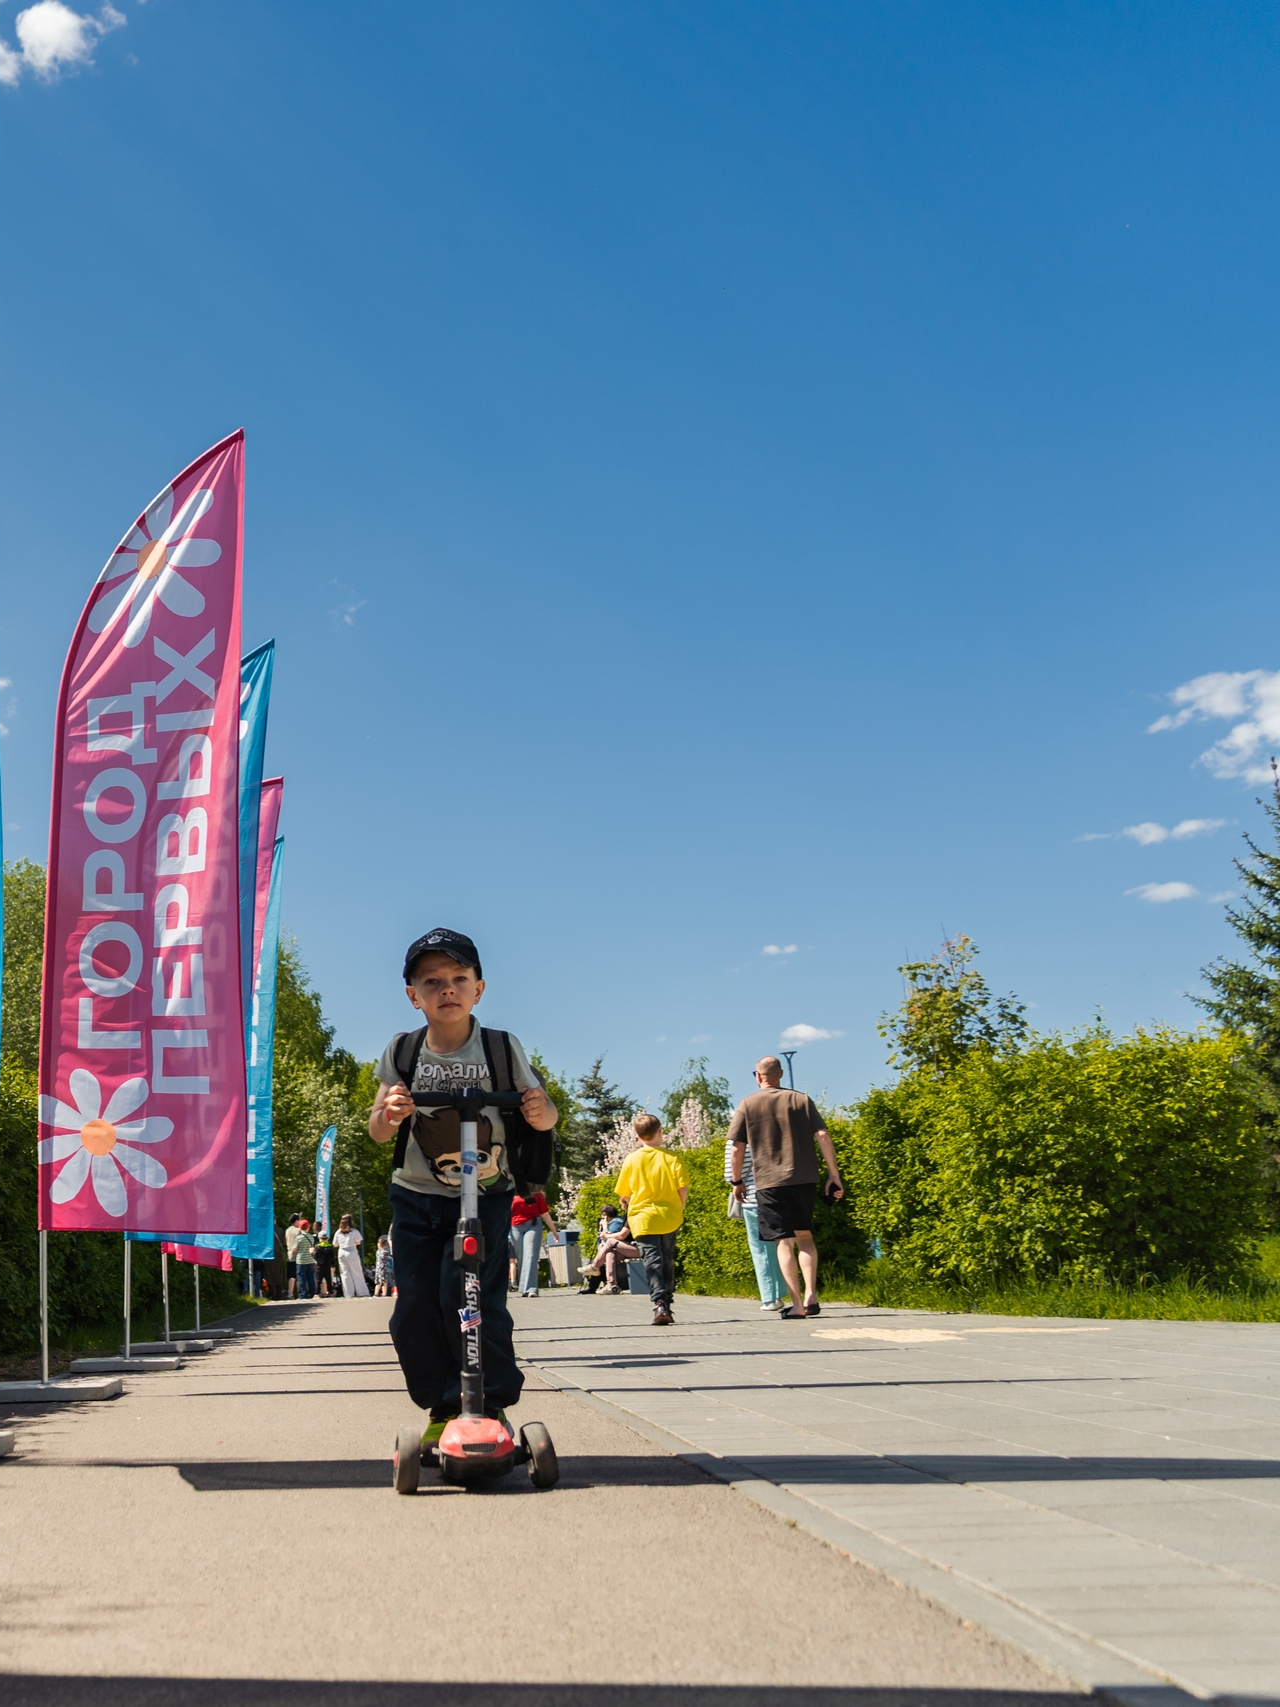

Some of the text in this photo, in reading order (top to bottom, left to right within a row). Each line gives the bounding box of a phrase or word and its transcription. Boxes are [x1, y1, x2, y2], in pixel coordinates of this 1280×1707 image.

[78, 682, 156, 1050] ГОРОД
[151, 627, 218, 1096] ПЕРВЫХ
[466, 1314, 480, 1366] CTION
